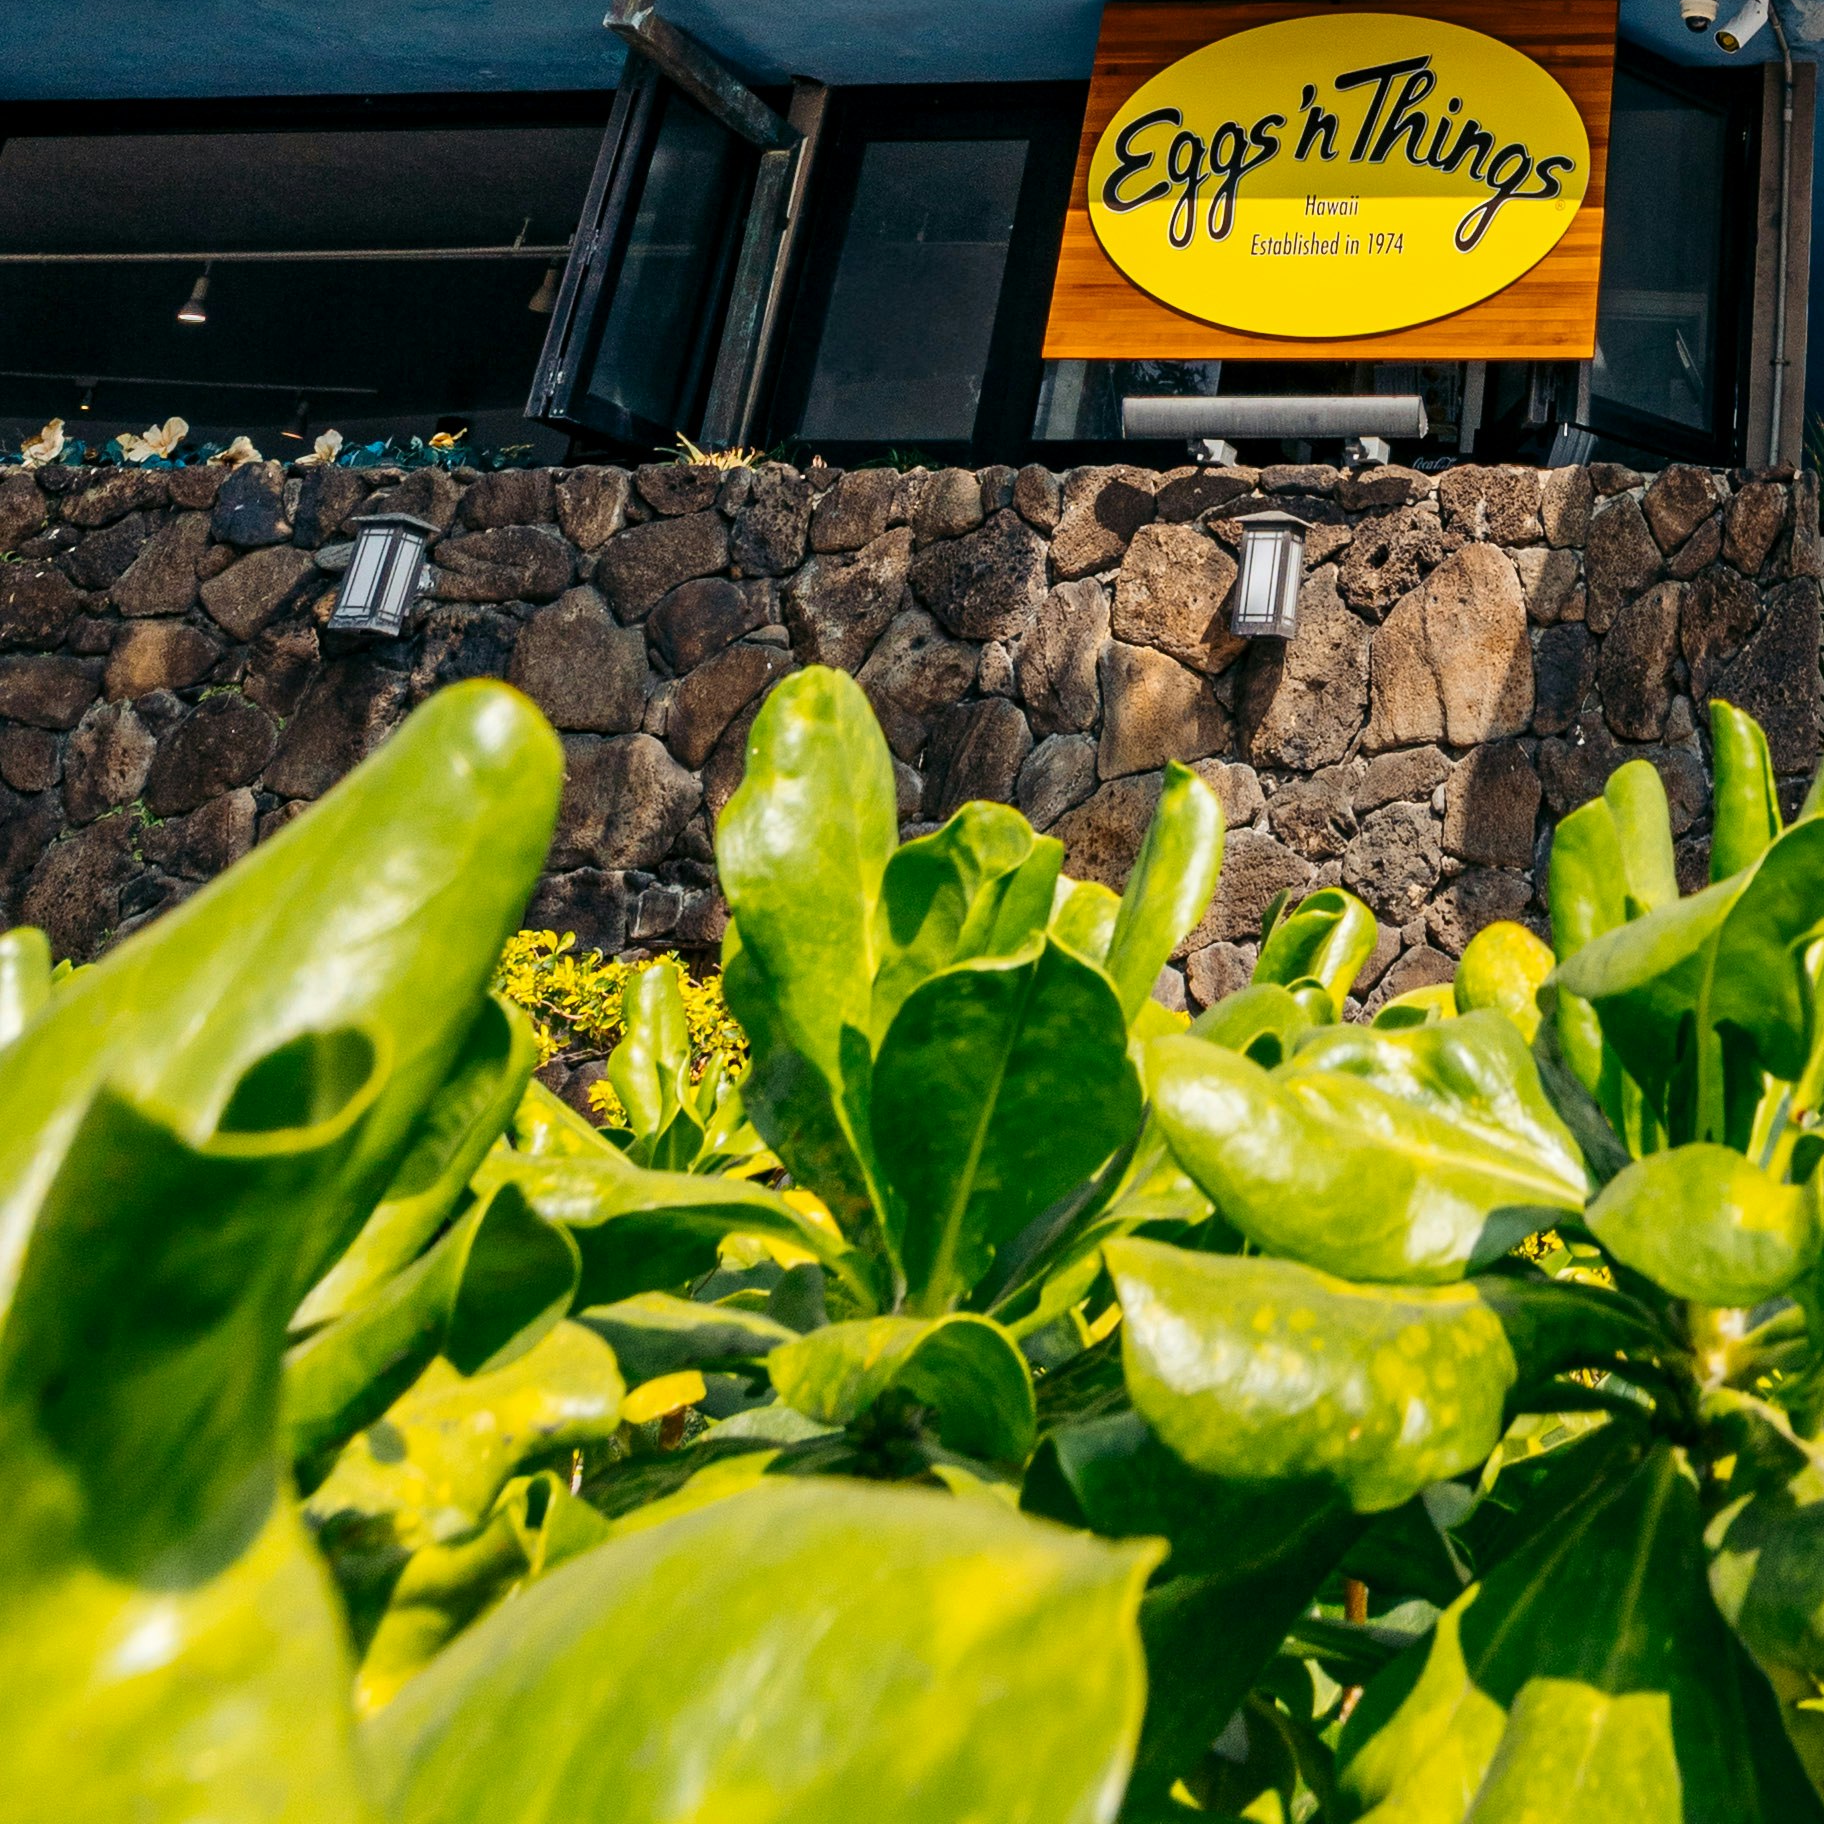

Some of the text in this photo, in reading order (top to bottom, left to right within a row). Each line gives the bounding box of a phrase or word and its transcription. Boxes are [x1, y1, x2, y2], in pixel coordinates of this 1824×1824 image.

[1103, 107, 1287, 249] Eggs
[1335, 54, 1575, 253] Things
[1304, 194, 1359, 217] Hawaii
[1250, 231, 1404, 256] Established in 1974
